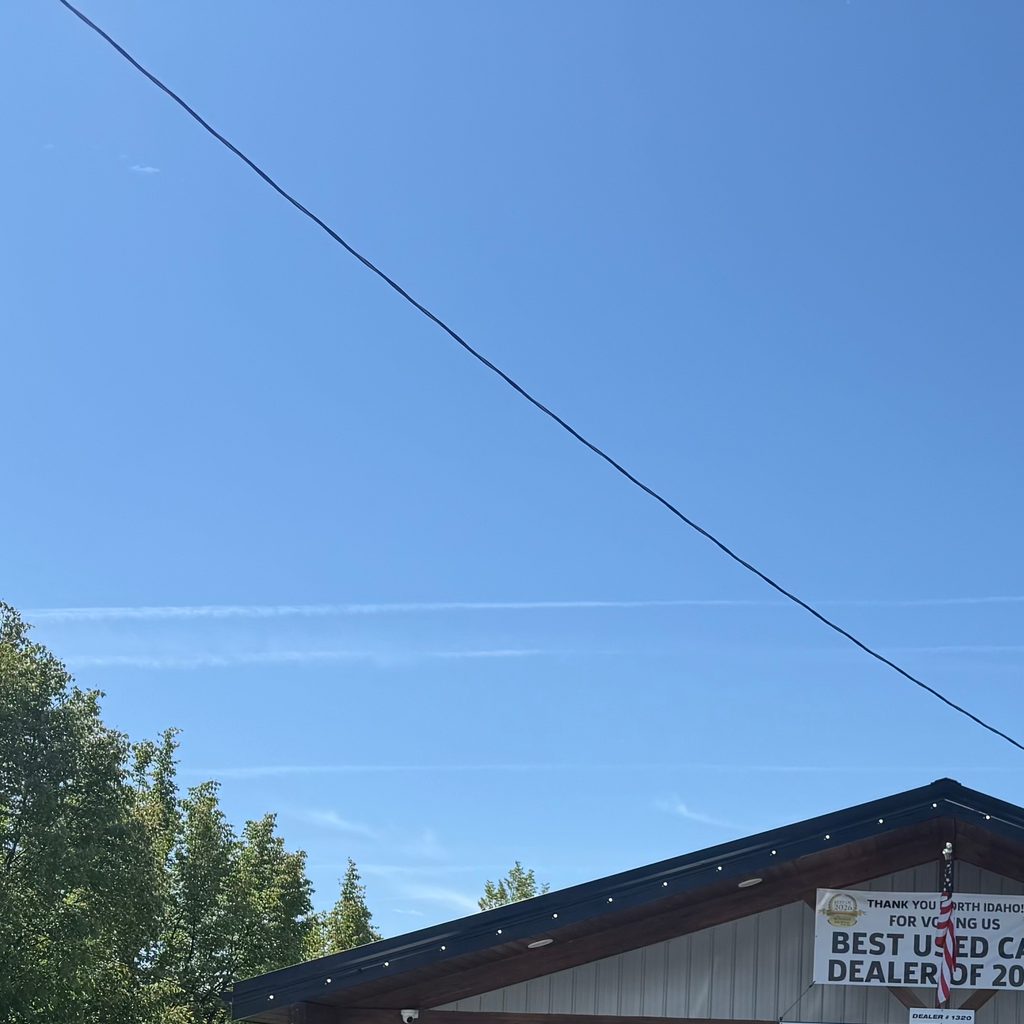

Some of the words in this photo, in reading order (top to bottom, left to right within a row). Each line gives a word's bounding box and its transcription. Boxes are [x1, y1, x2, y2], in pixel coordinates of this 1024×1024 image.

[867, 899, 909, 909] THANK
[912, 900, 936, 910] YOU
[983, 902, 1024, 913] IDAHO!
[889, 915, 917, 927] FOR
[921, 916, 977, 929] VONG
[981, 918, 1001, 930] US
[831, 931, 905, 956] BEST
[913, 934, 989, 958] UED
[828, 959, 938, 985] DEALER
[950, 963, 984, 986] OF
